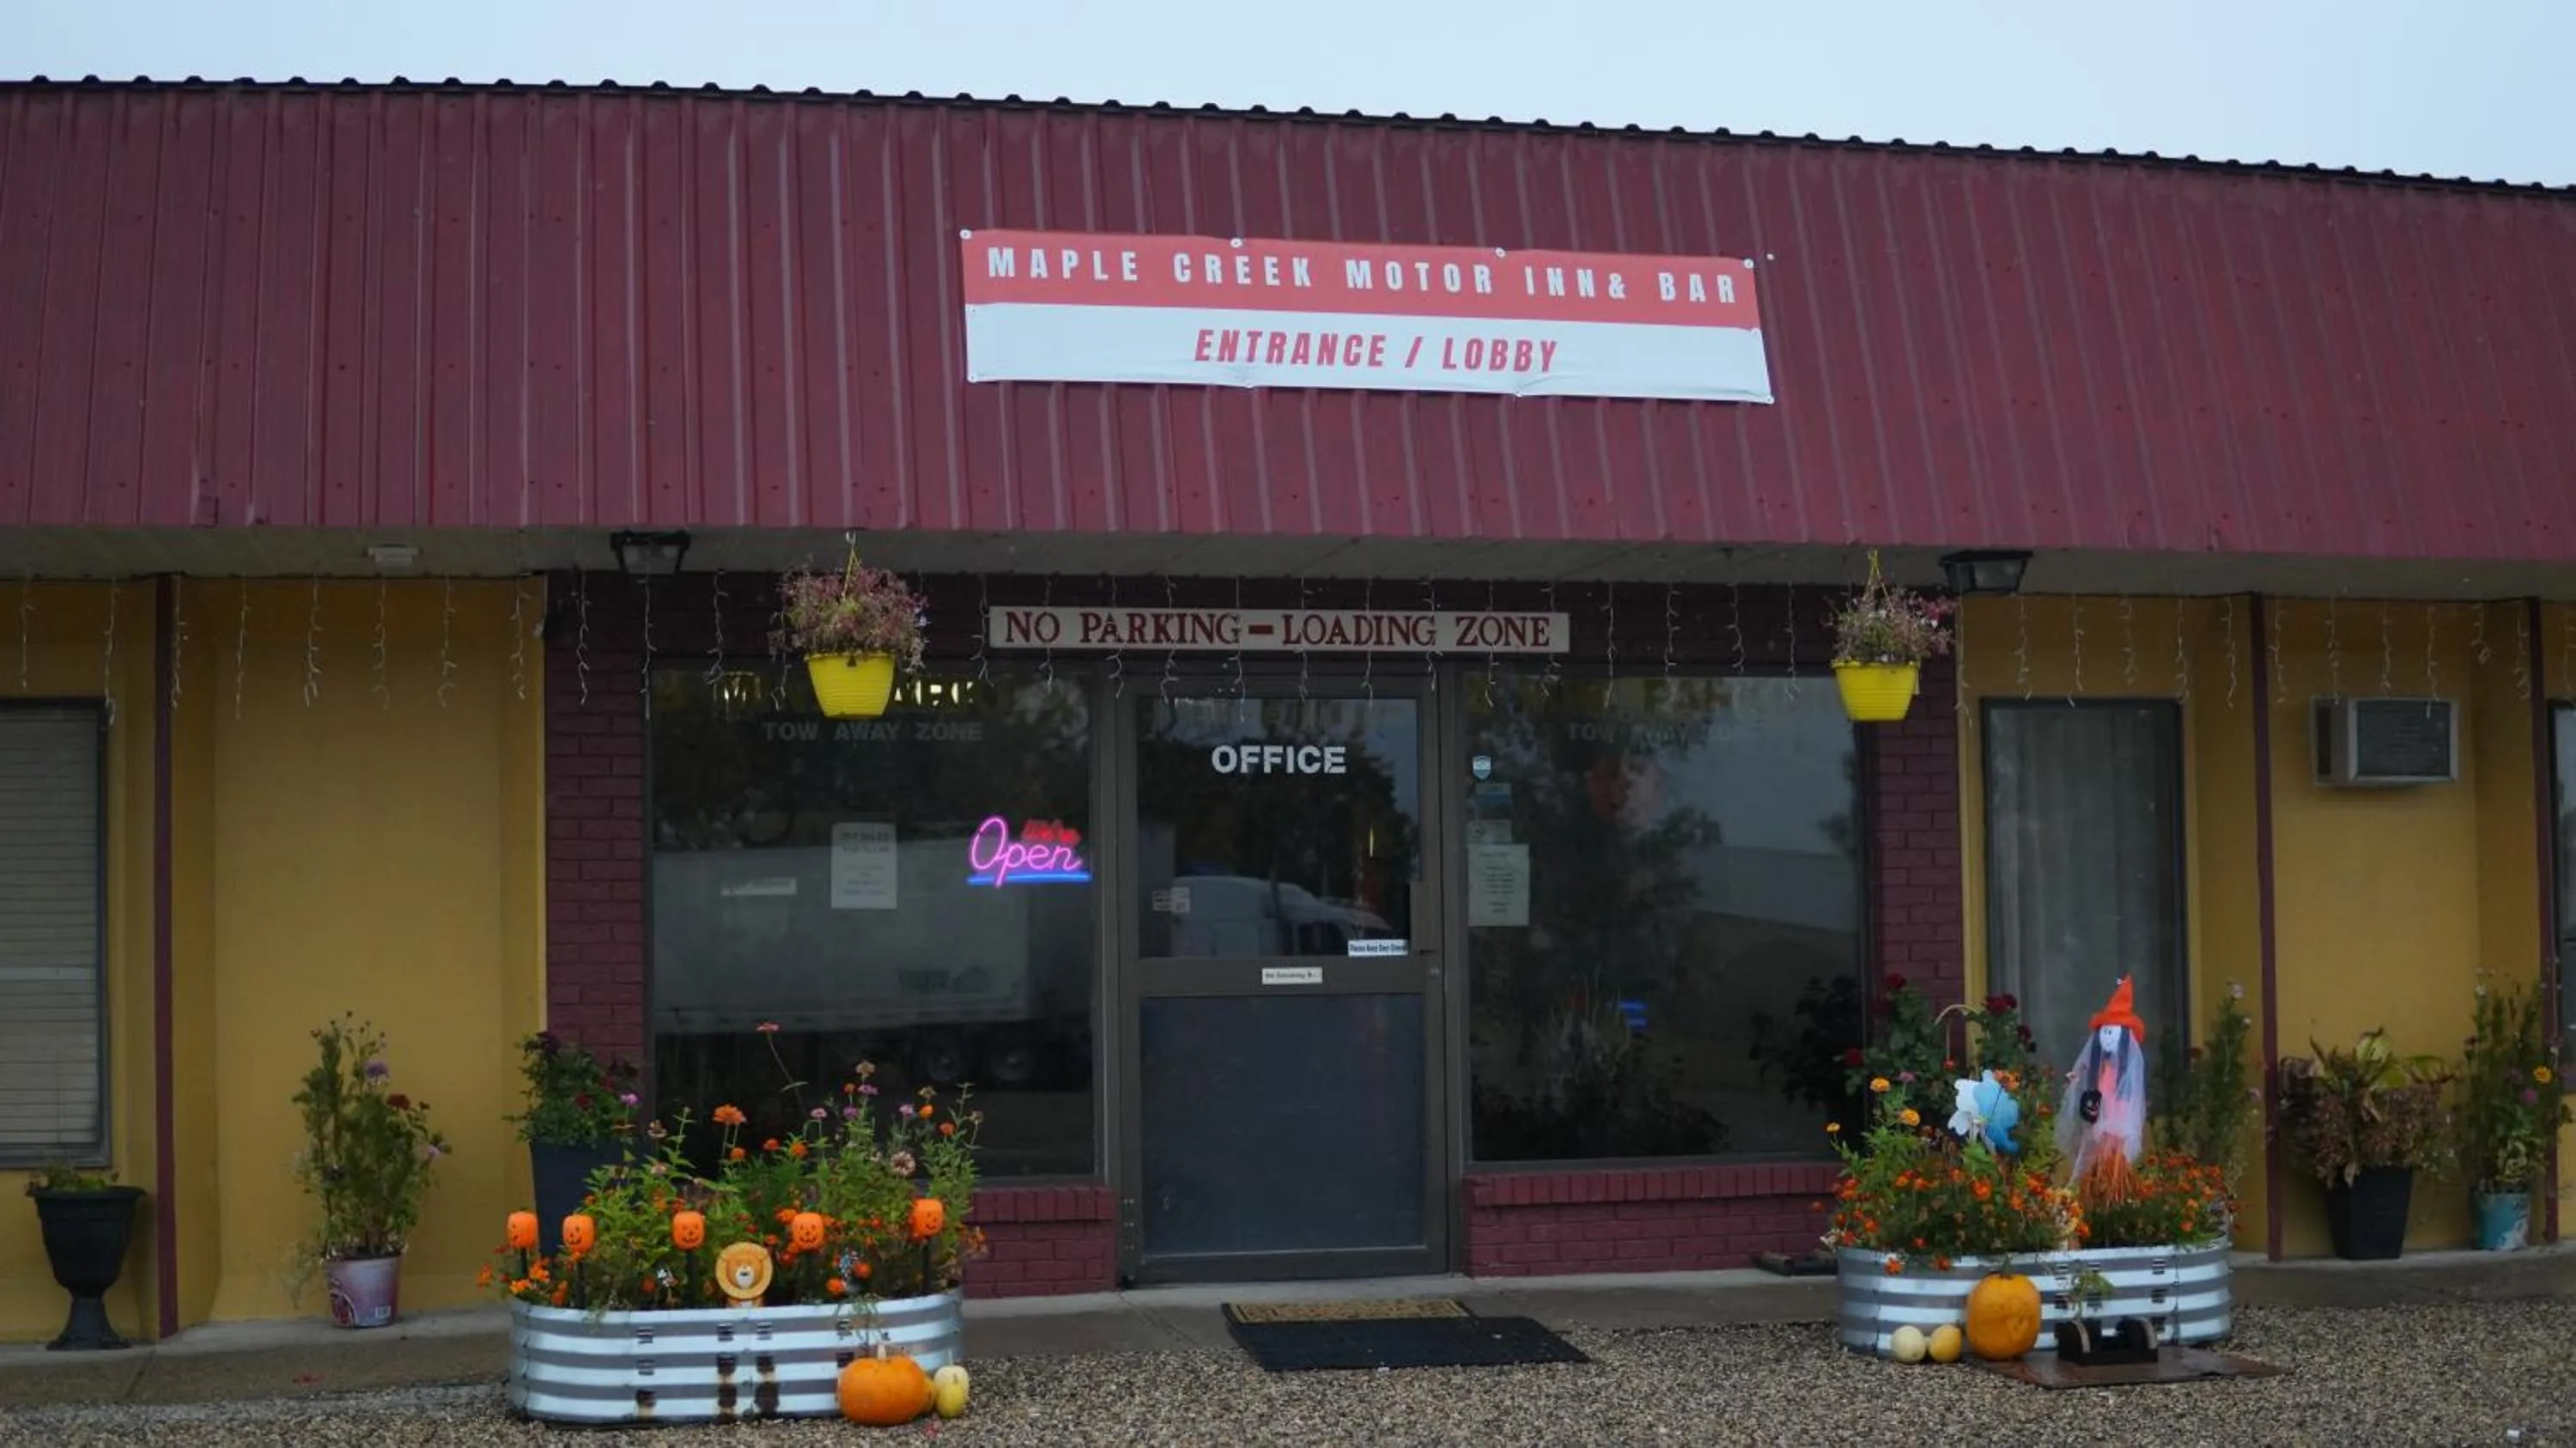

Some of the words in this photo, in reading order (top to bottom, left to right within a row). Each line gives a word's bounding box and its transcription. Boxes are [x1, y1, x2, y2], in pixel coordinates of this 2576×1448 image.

[987, 246, 1138, 281] MAPLE
[1173, 253, 1311, 287] CREEK
[1346, 259, 1492, 294] MOTOR
[1658, 273, 1736, 303] BAR
[1194, 329, 1386, 368] ENTRANCE
[1404, 336, 1423, 368] /
[1442, 338, 1558, 373] LOBBY
[1004, 611, 1061, 644] NO
[1079, 611, 1242, 646] PARKING
[1282, 614, 1437, 647] LOADING
[1454, 615, 1552, 648] ZONE
[761, 721, 819, 742] TOW
[833, 721, 900, 742] AWAY
[914, 721, 984, 742] ZONE
[1211, 745, 1346, 774] OFFICE
[970, 816, 1084, 888] Open
